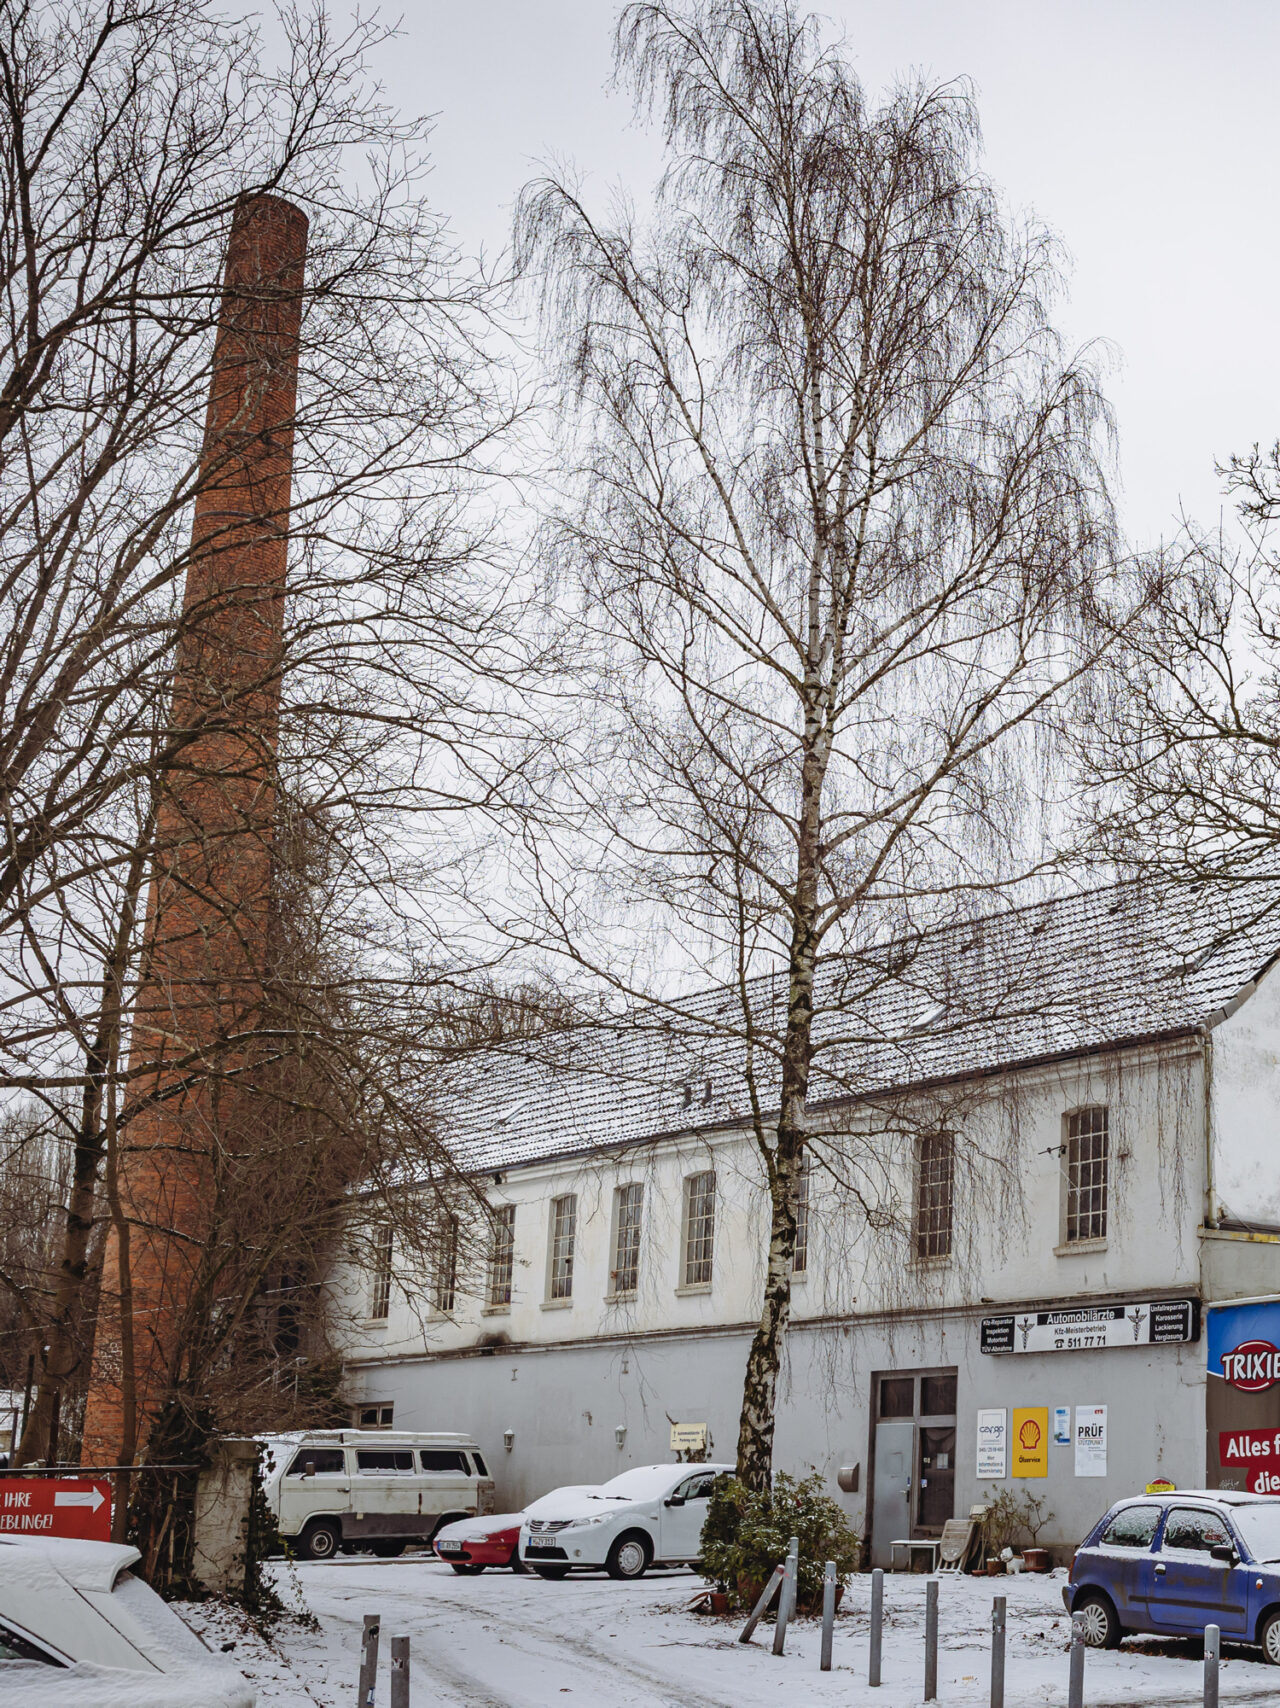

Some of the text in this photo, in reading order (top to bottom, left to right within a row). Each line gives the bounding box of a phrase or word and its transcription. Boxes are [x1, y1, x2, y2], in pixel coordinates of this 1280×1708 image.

[1150, 1303, 1188, 1312] Unfallreparatur
[1047, 1309, 1115, 1325] Automobilärzte
[1156, 1313, 1183, 1321] Karosserie
[1054, 1324, 1107, 1335] Kfz-Meisterbetrieb
[1155, 1322, 1183, 1332] Lackierung
[1068, 1336, 1106, 1348] 511 77 71
[1155, 1333, 1183, 1342] Verglasung
[1078, 1423, 1104, 1438] PRÜF
[1226, 1436, 1270, 1458] Alles
[1018, 1454, 1040, 1464] Ölservice
[1254, 1471, 1280, 1494] die
[4, 1492, 32, 1508] IHRE
[0, 1514, 54, 1530] EBLINGE!
